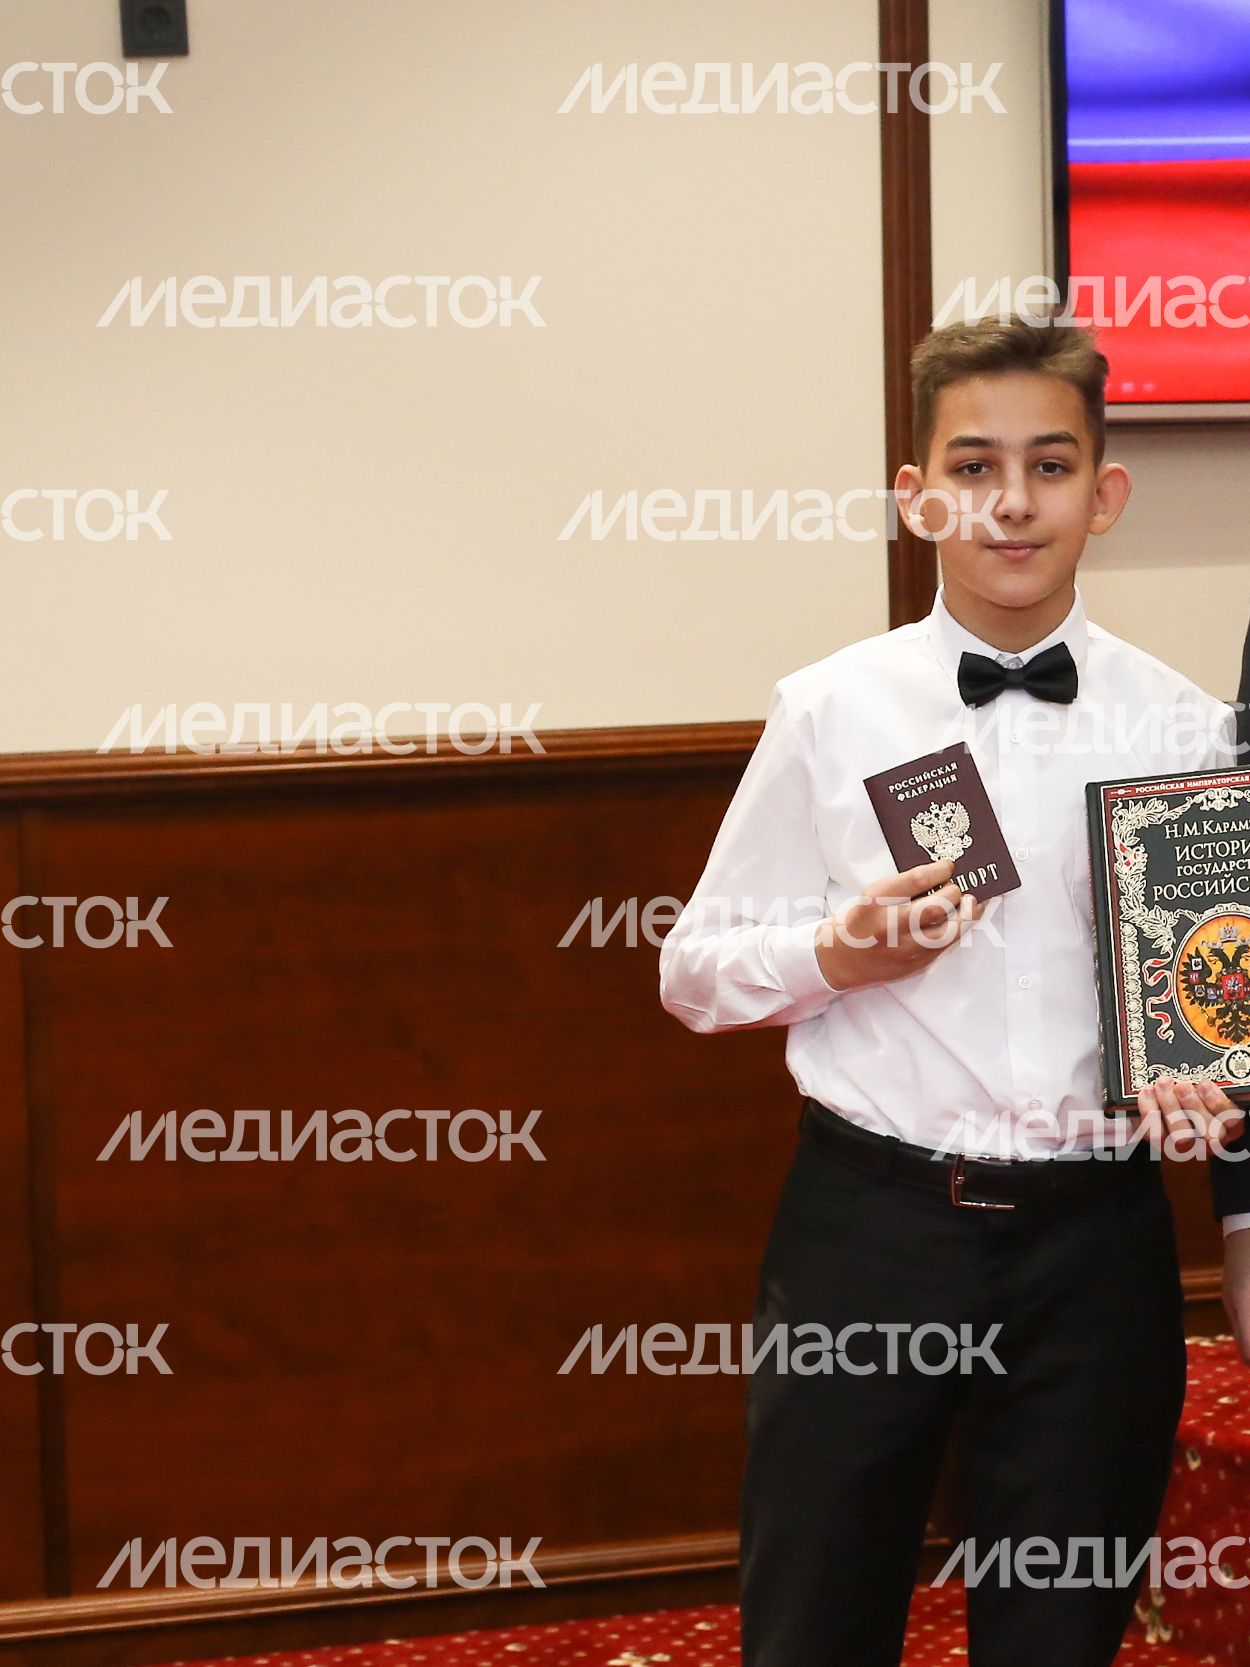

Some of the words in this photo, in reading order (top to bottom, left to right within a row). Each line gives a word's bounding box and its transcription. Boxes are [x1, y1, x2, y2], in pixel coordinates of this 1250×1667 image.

[888, 762, 958, 793] РОССИЙСКАЯ
[897, 774, 958, 802] ФЕДЕРАЦИЯ
[1135, 783, 1185, 794] РОССИЙСКАЯ
[1187, 776, 1250, 788] ИМПЕРАТОРСКАЯ
